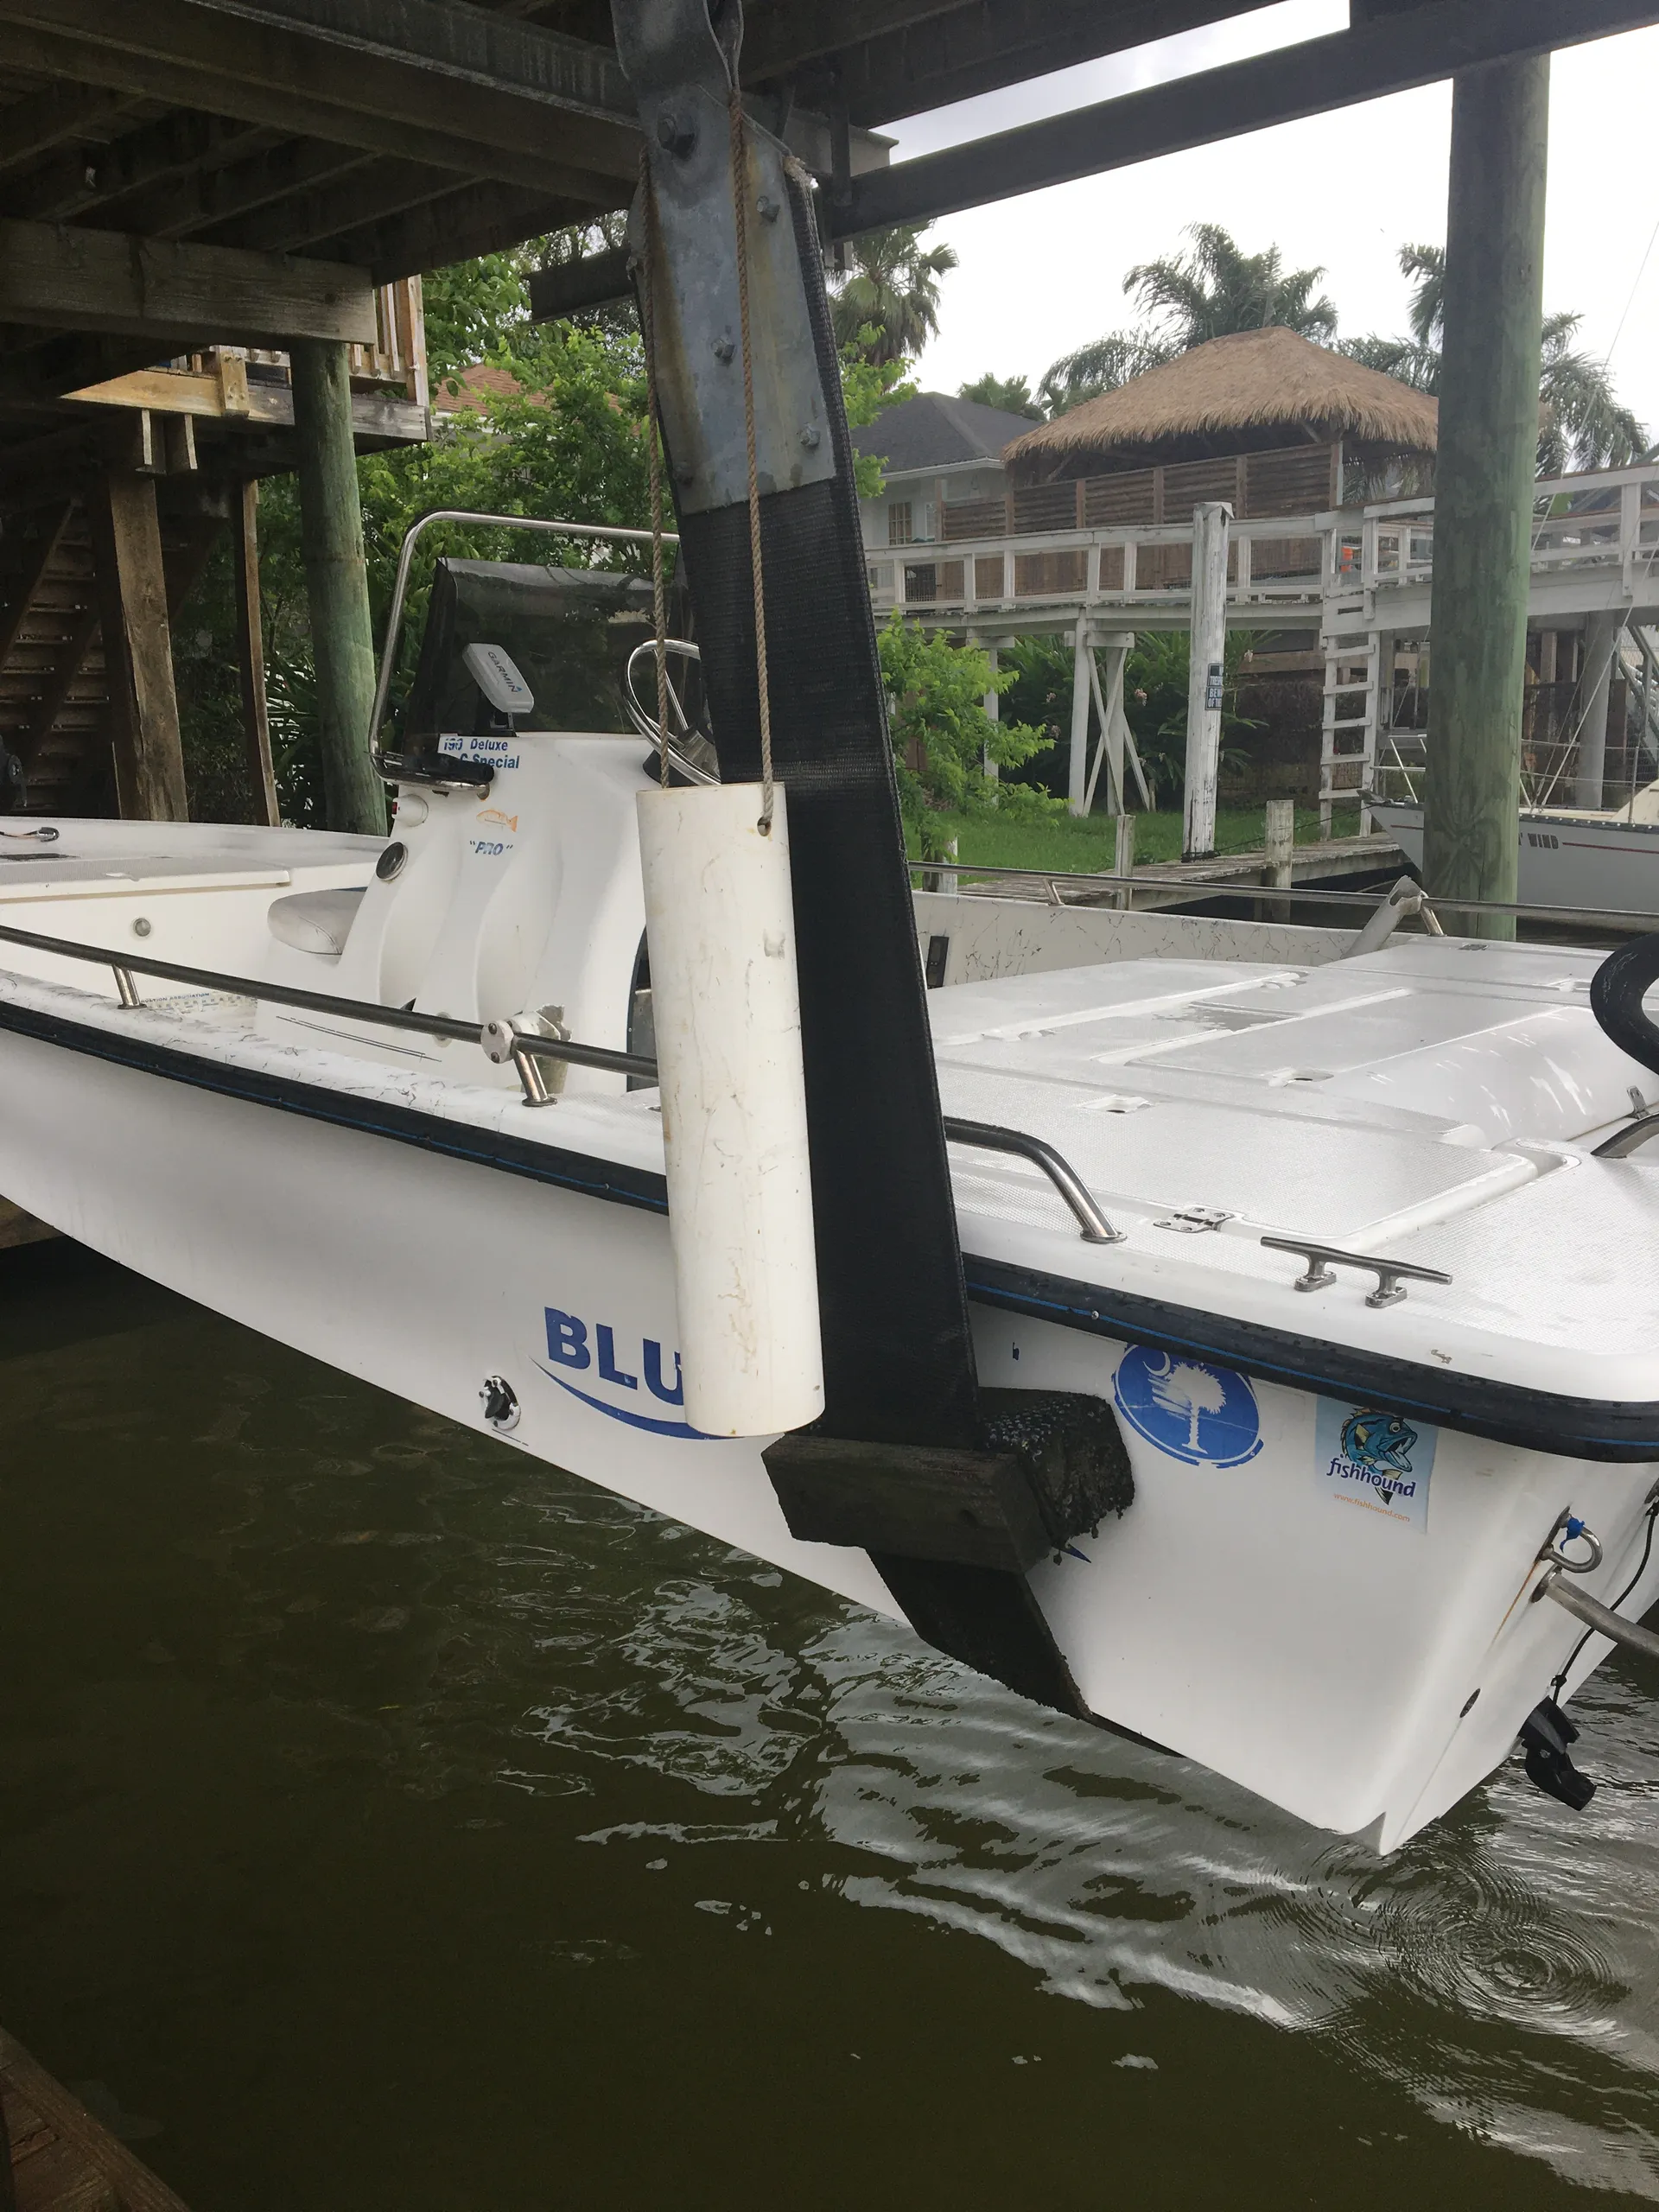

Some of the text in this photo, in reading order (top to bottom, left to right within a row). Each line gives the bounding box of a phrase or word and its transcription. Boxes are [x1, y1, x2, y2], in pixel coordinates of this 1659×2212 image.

[487, 651, 518, 693] GARMIN
[470, 738, 508, 751] Deluxe
[544, 1306, 684, 1406] BLU
[1325, 1453, 1417, 1497] fishhound
[1333, 1493, 1411, 1522] www.fishhound.com
